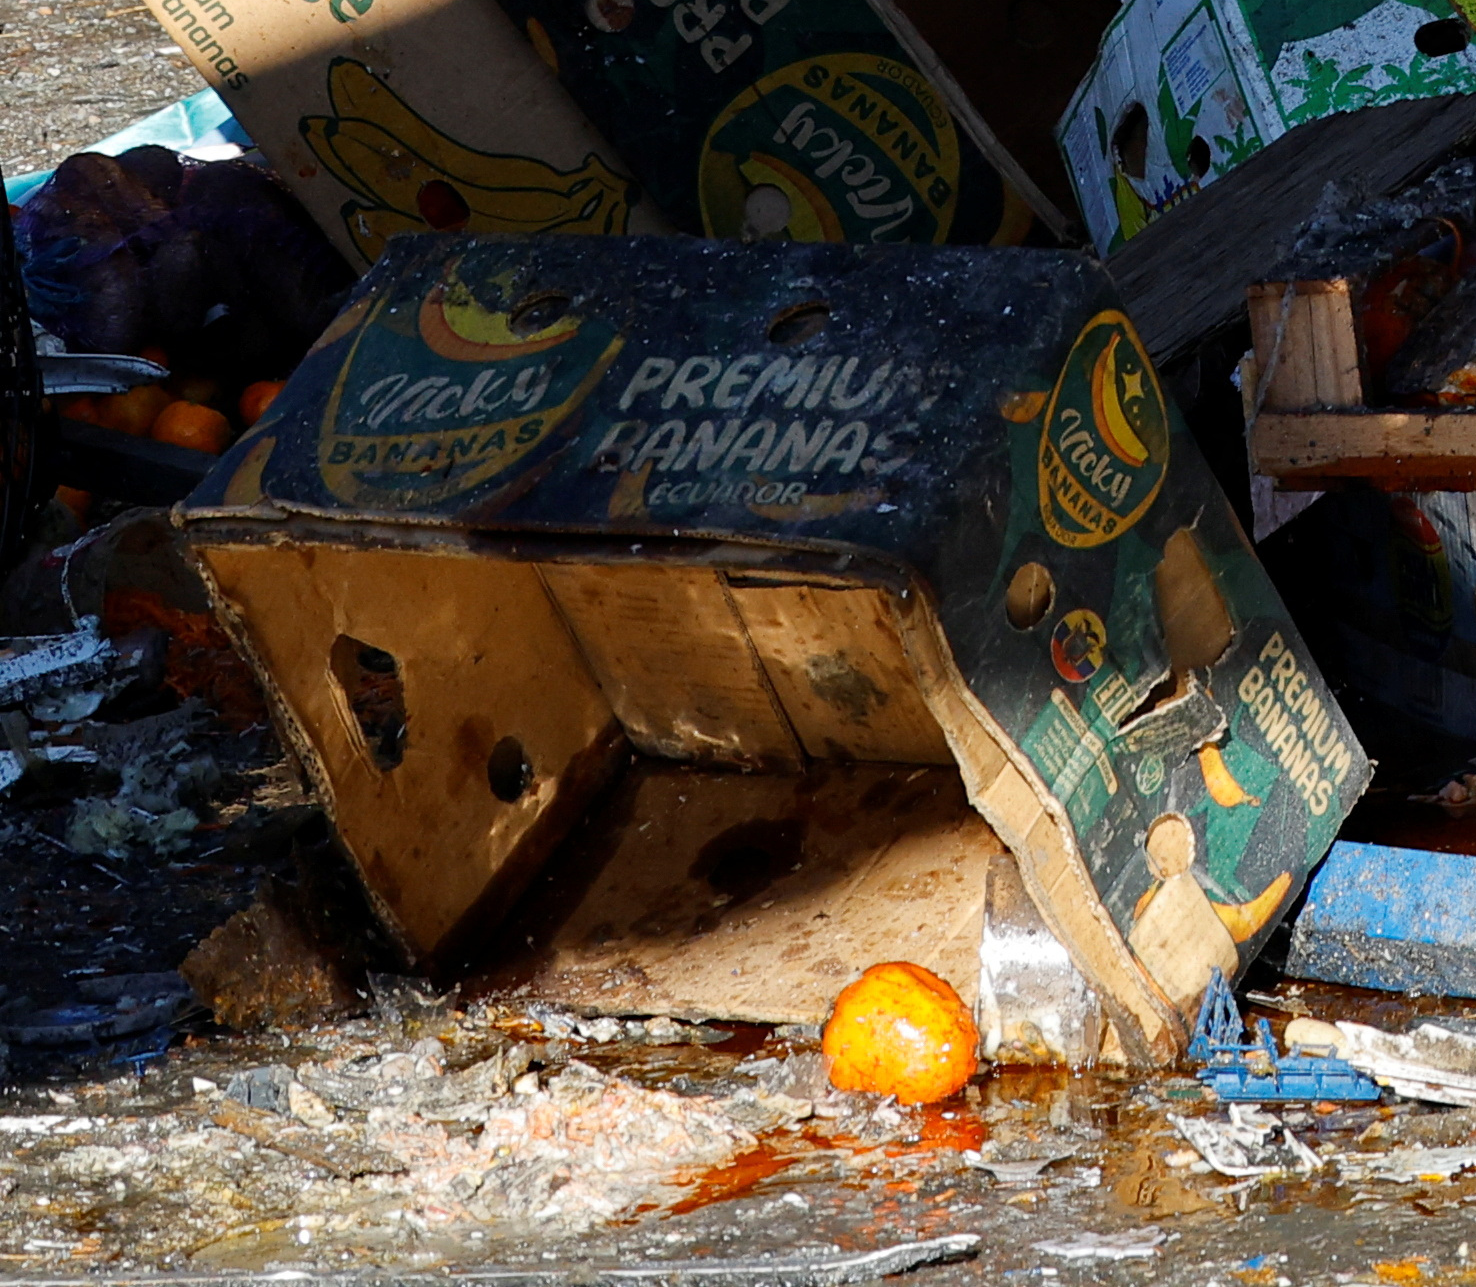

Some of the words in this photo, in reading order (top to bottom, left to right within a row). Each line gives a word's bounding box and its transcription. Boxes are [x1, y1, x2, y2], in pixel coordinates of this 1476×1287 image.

[803, 62, 952, 210] BANANAS
[874, 58, 951, 130] ECUADOR
[772, 99, 916, 244] Vicky
[357, 355, 563, 429] Vicky
[326, 415, 545, 469] BANANAS
[594, 420, 921, 476] BANANAS
[1059, 406, 1134, 507] Vicky
[646, 479, 808, 508] ECUADOR
[1041, 447, 1118, 537] BANANAS
[1237, 664, 1330, 817] BANANAS
[1258, 629, 1352, 787] PREMIUM
